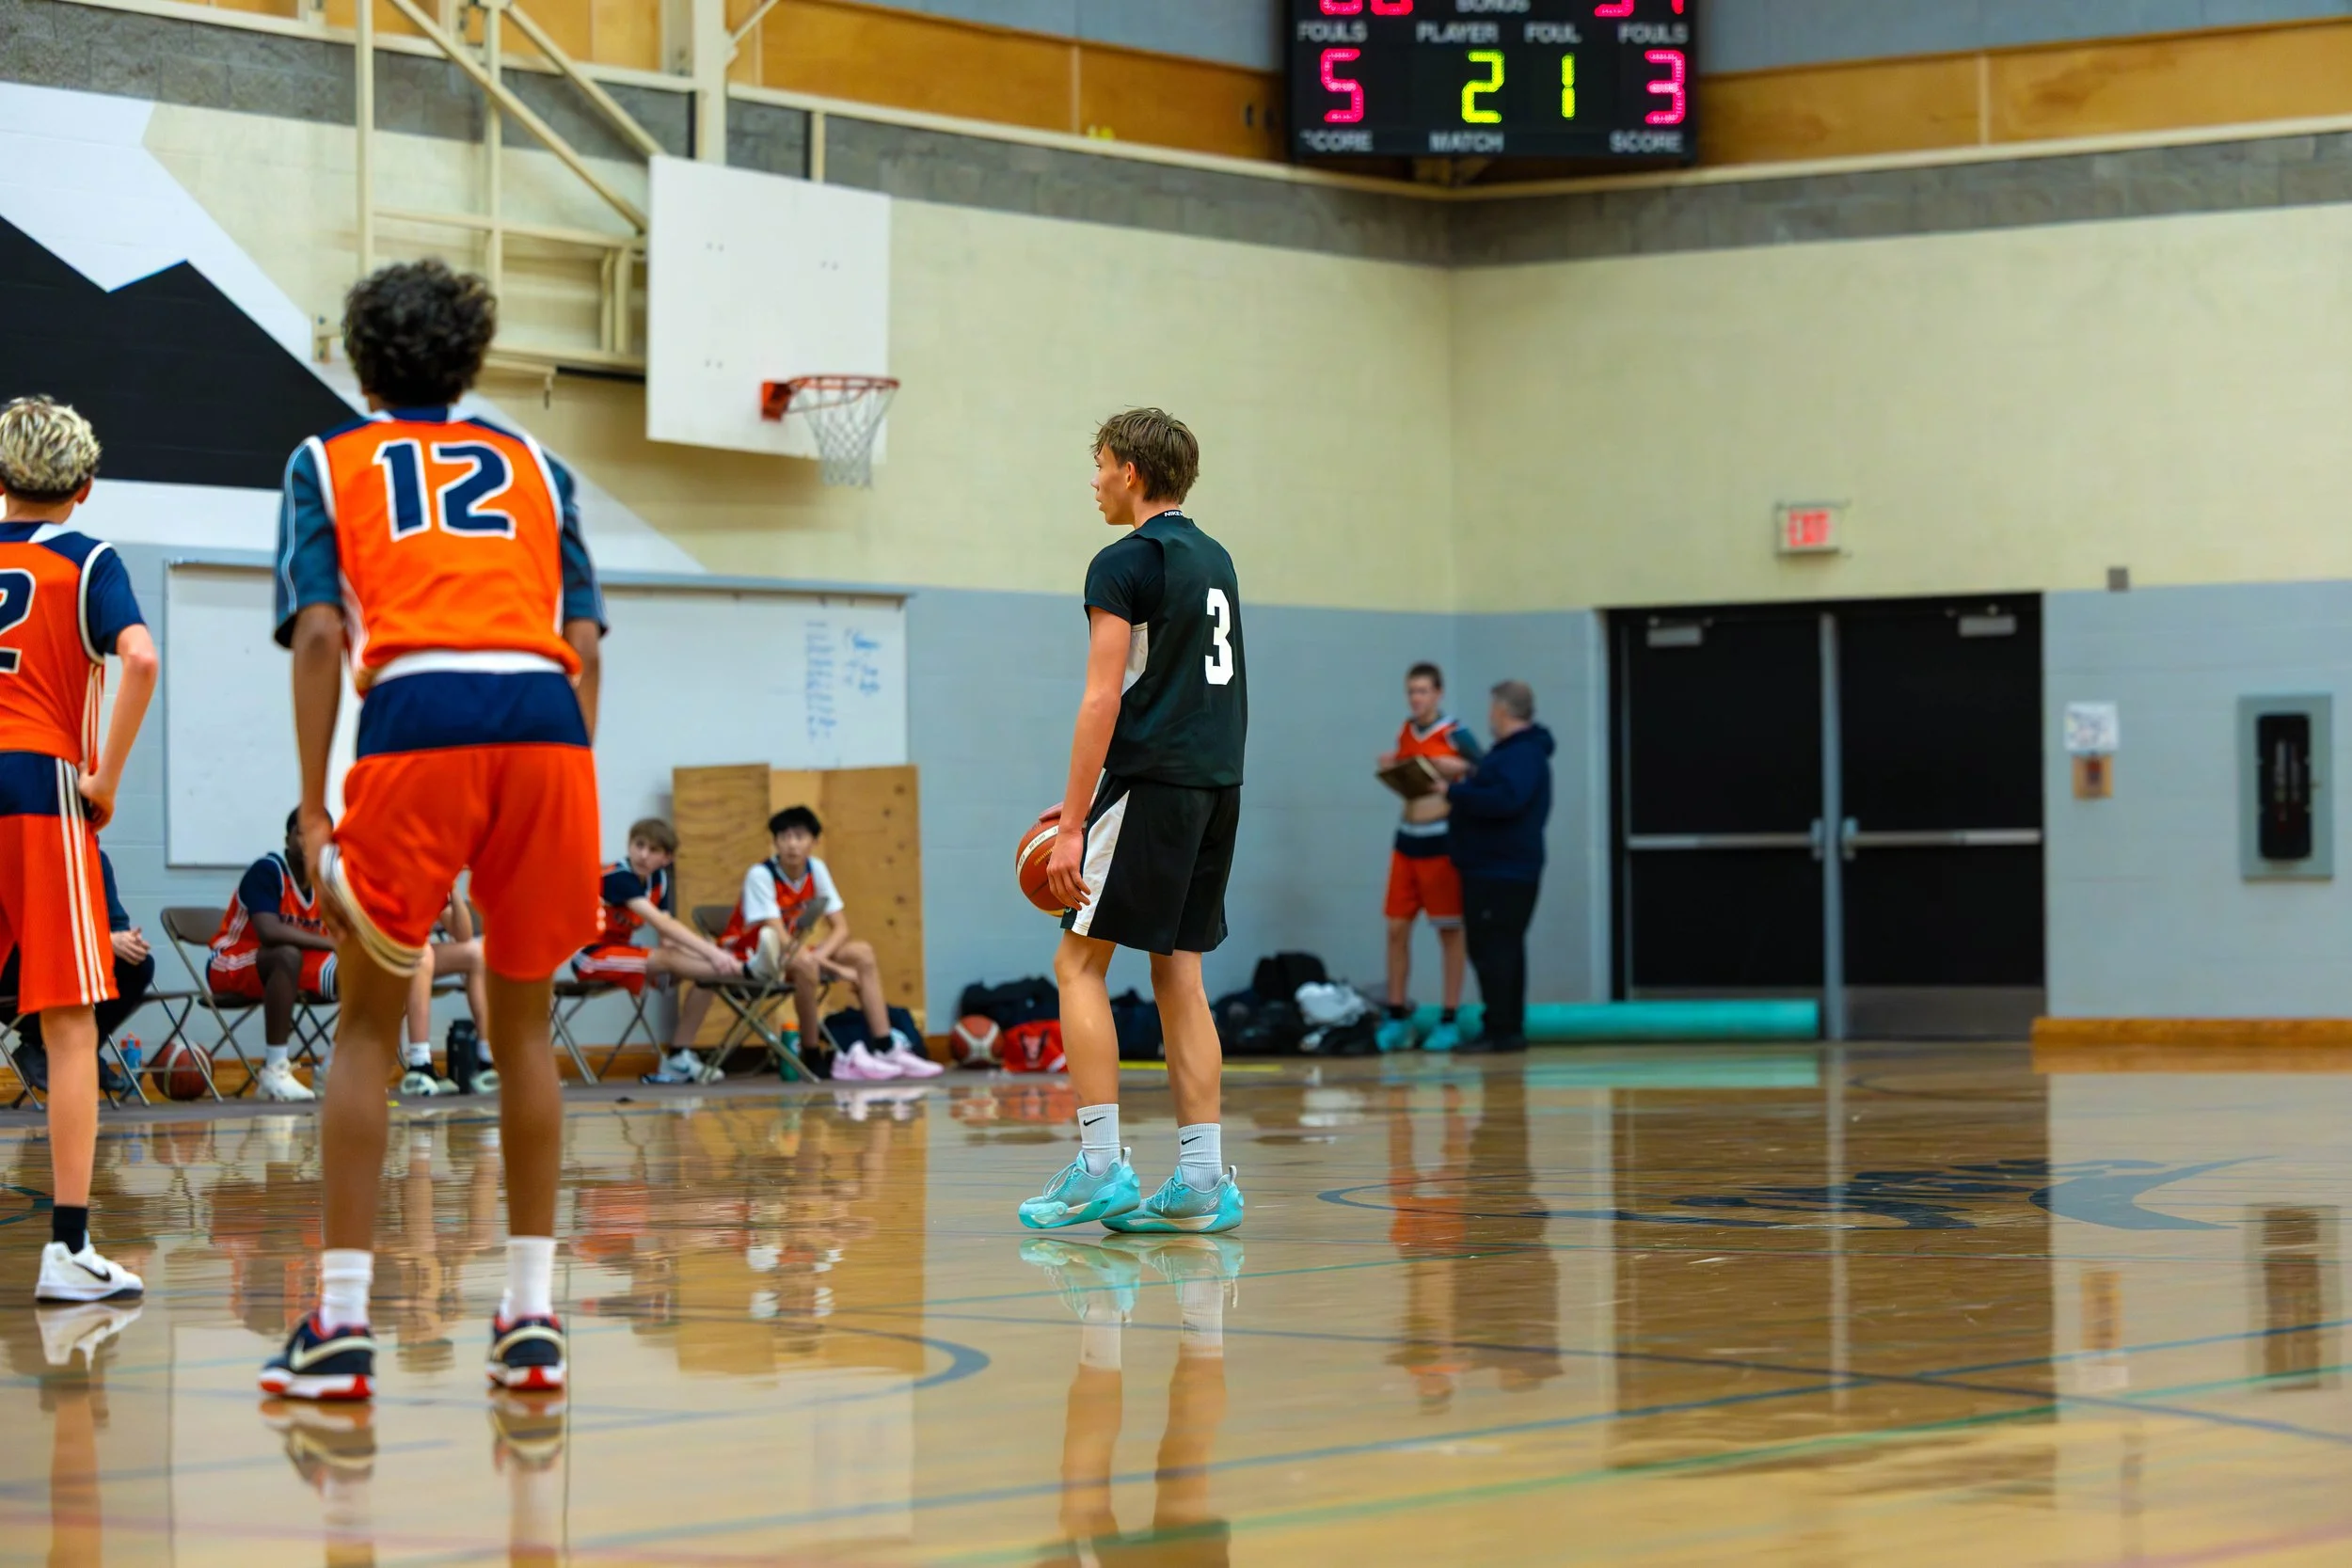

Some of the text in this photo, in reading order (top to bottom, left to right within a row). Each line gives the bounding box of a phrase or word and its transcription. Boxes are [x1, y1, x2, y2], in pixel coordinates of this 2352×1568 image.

[1297, 22, 1367, 42] FOULS
[1416, 23, 1581, 43] PLAYER FOUL
[1618, 23, 1689, 44] FOULS
[1320, 49, 1364, 123] 5
[1462, 51, 1575, 123] 2 1
[1645, 50, 1685, 124] 3
[1429, 131, 1503, 151] MATCH
[1610, 130, 1683, 152] SCORE
[372, 437, 516, 543] 12
[1205, 588, 1234, 686] 3
